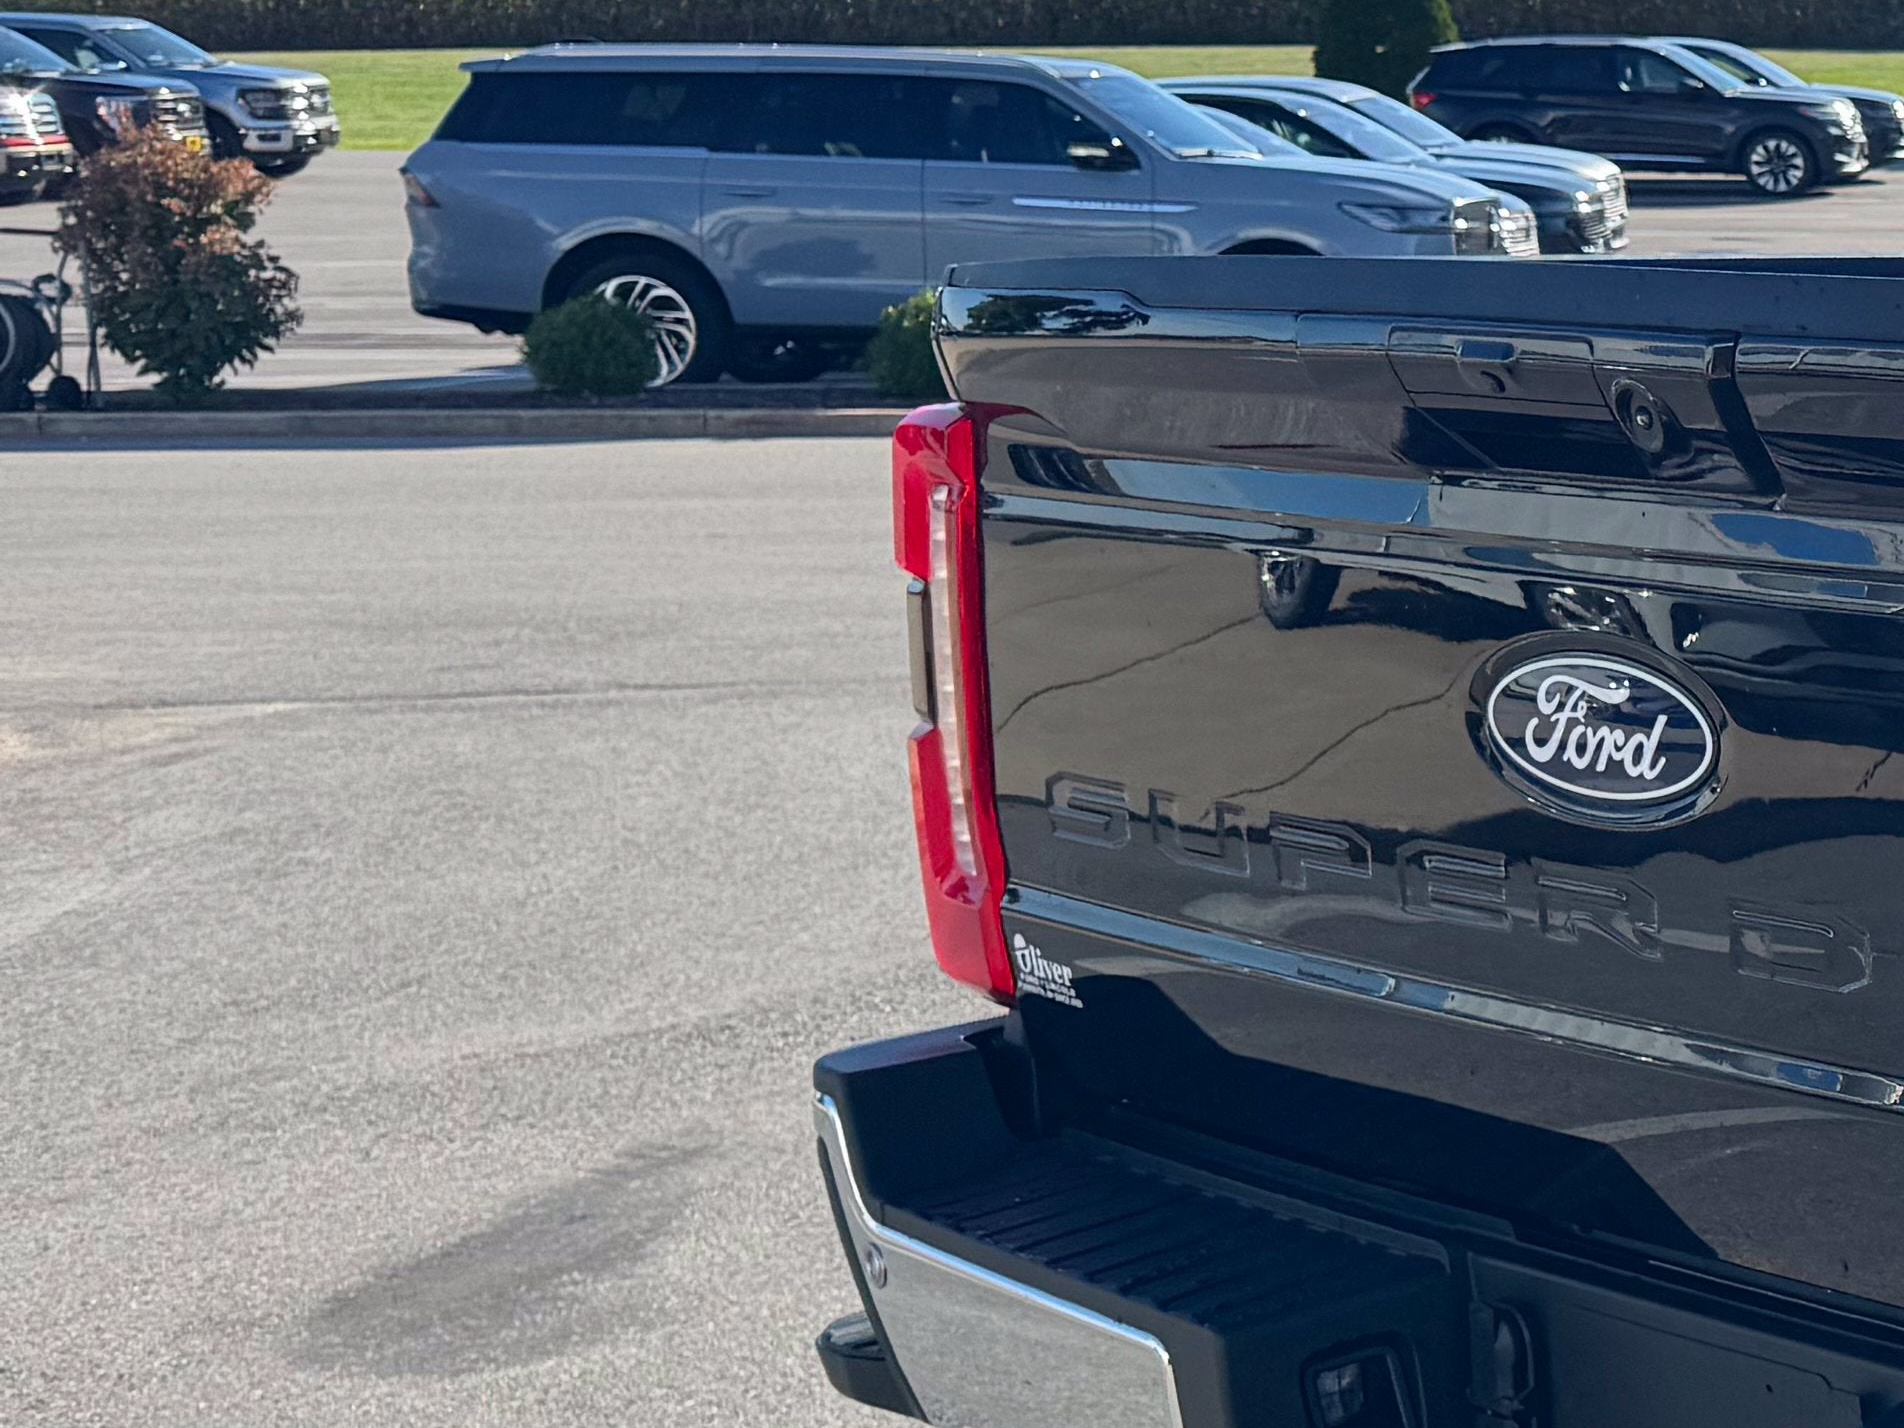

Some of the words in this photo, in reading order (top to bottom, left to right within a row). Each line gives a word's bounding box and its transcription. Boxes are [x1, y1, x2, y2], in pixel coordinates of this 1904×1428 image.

[1524, 674, 1669, 781] Ford
[1044, 772, 1661, 963] SUPER
[1014, 943, 1073, 987] Oliver
